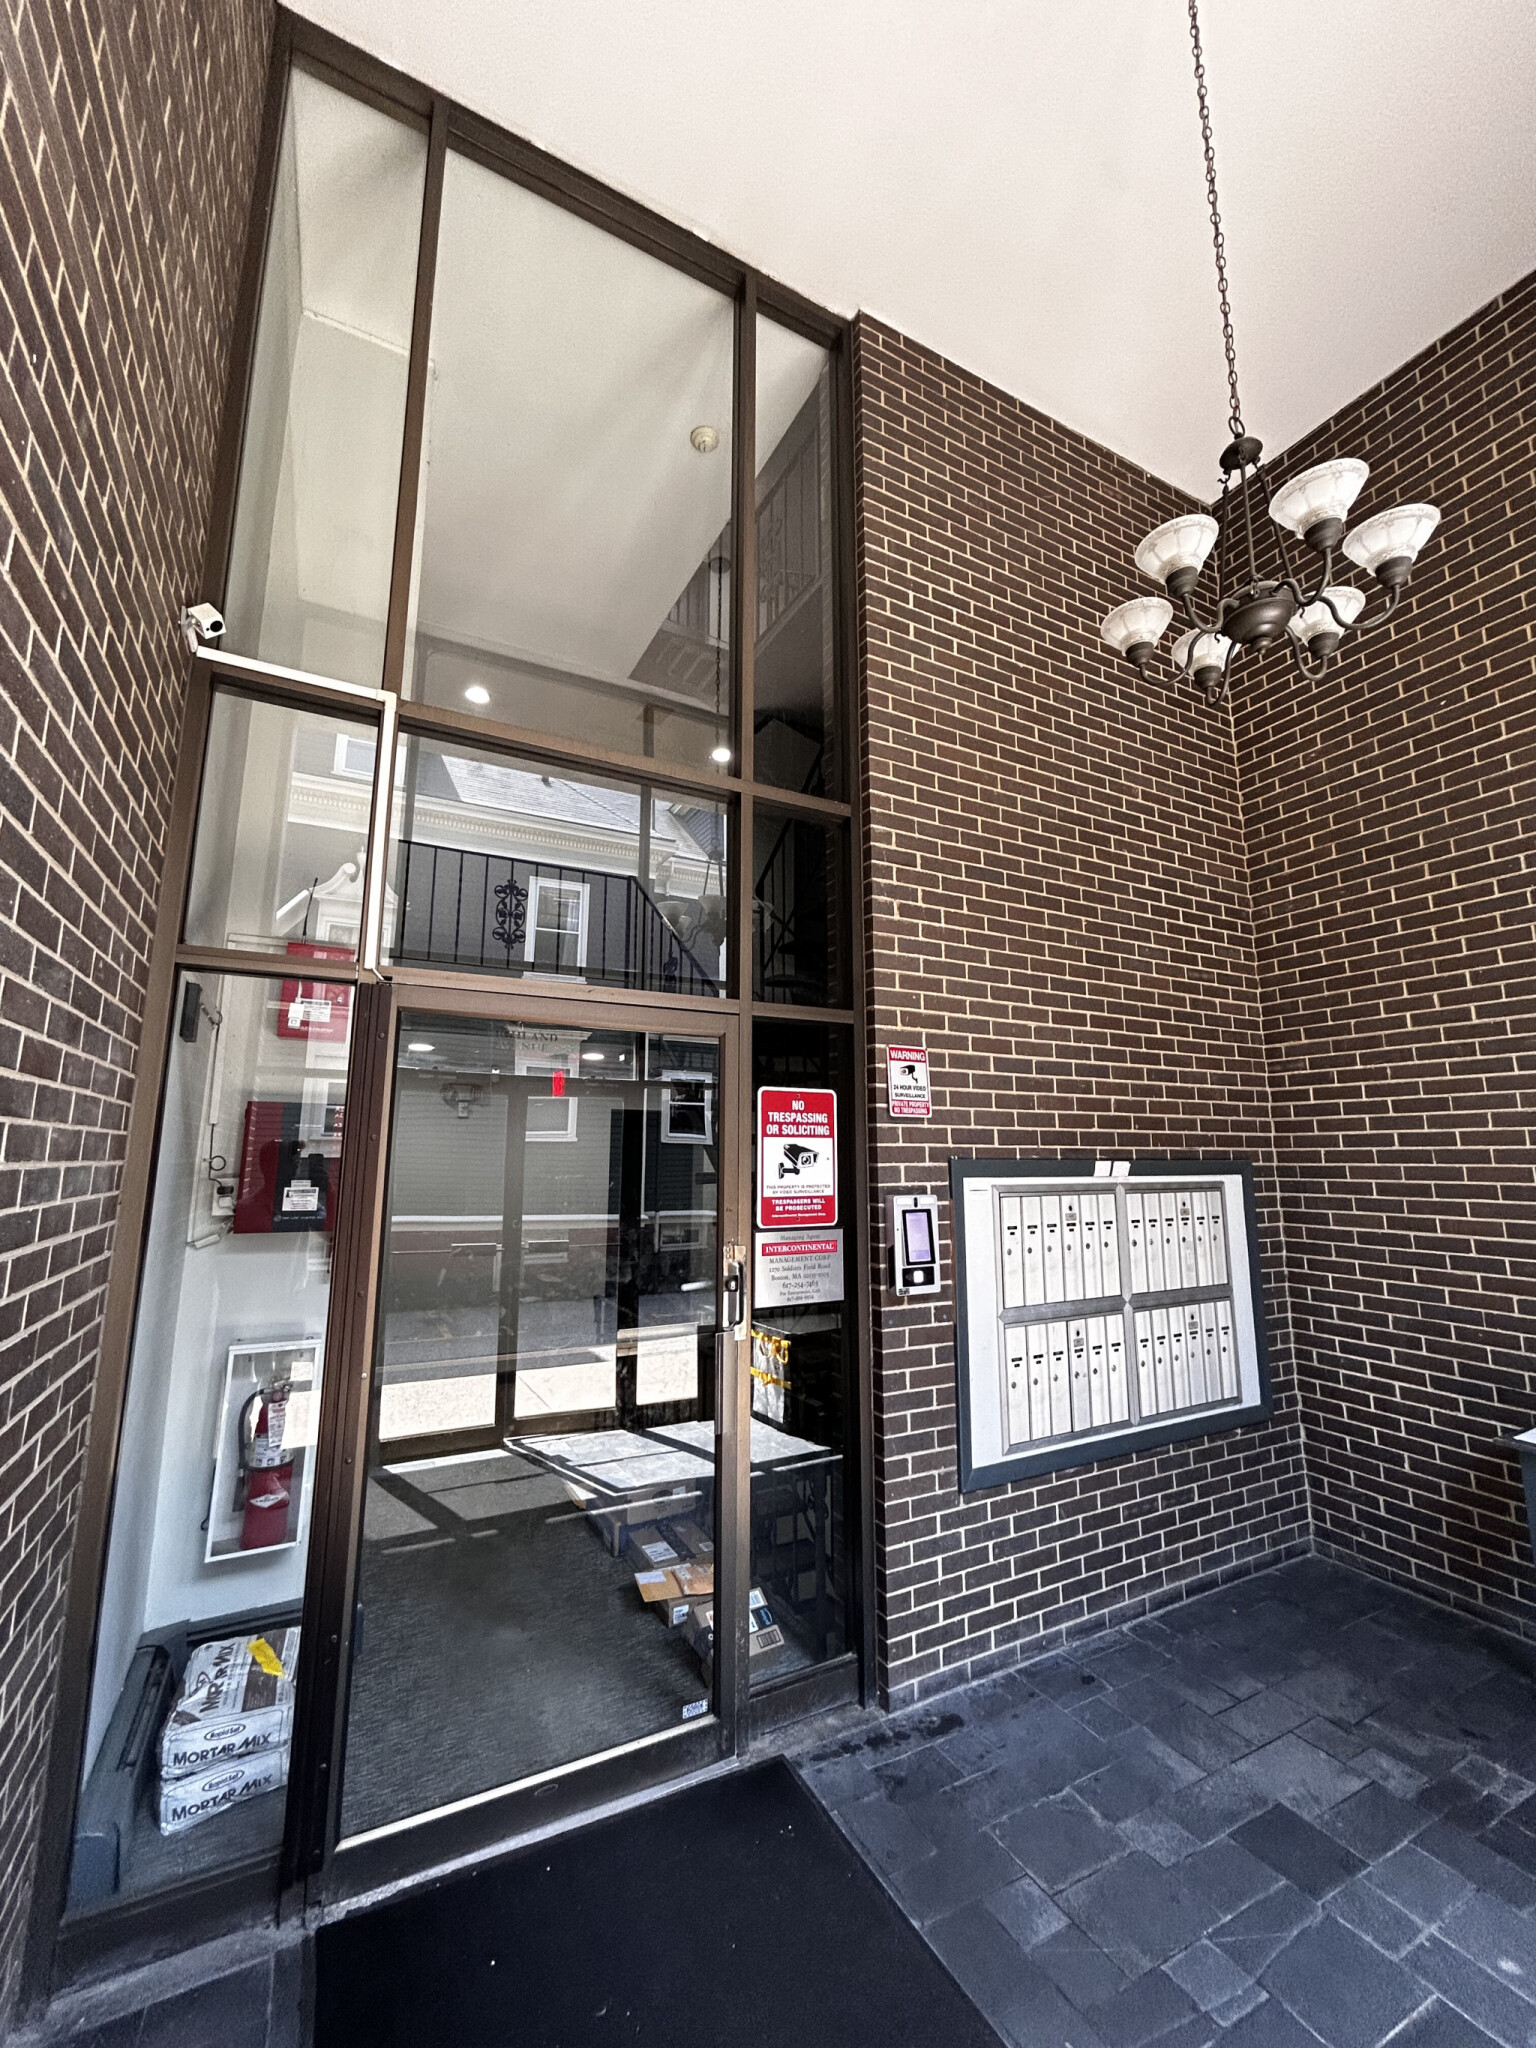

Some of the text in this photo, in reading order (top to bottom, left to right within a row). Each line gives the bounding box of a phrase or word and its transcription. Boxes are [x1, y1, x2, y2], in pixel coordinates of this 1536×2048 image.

[890, 1050, 926, 1061] WARNING
[791, 1100, 805, 1111] NO
[767, 1111, 828, 1123] TRESPASSING
[766, 1124, 830, 1135] OR SOLICITING
[765, 1243, 834, 1253] INTERCONTINENTAL
[173, 1732, 272, 1766] MORTAR MIX
[172, 1774, 272, 1821] MORTAR MIX
